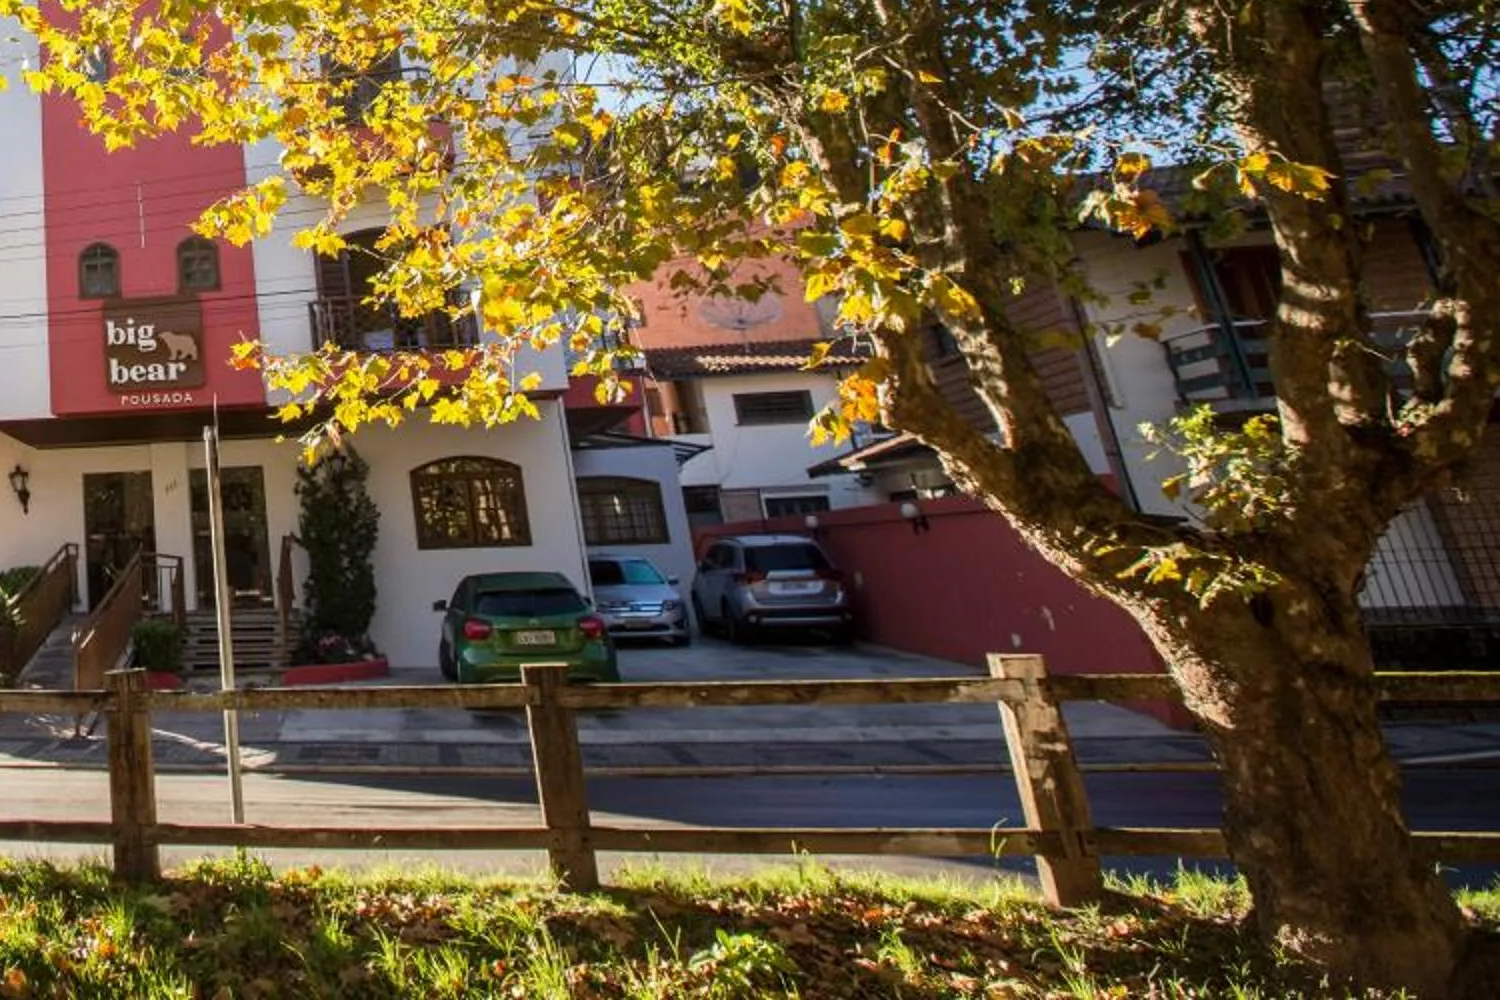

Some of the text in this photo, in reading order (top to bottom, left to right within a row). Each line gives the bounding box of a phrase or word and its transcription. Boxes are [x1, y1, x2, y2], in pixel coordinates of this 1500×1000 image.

[106, 318, 157, 352] big
[109, 358, 187, 384] bear
[121, 392, 193, 405] POUSADA
